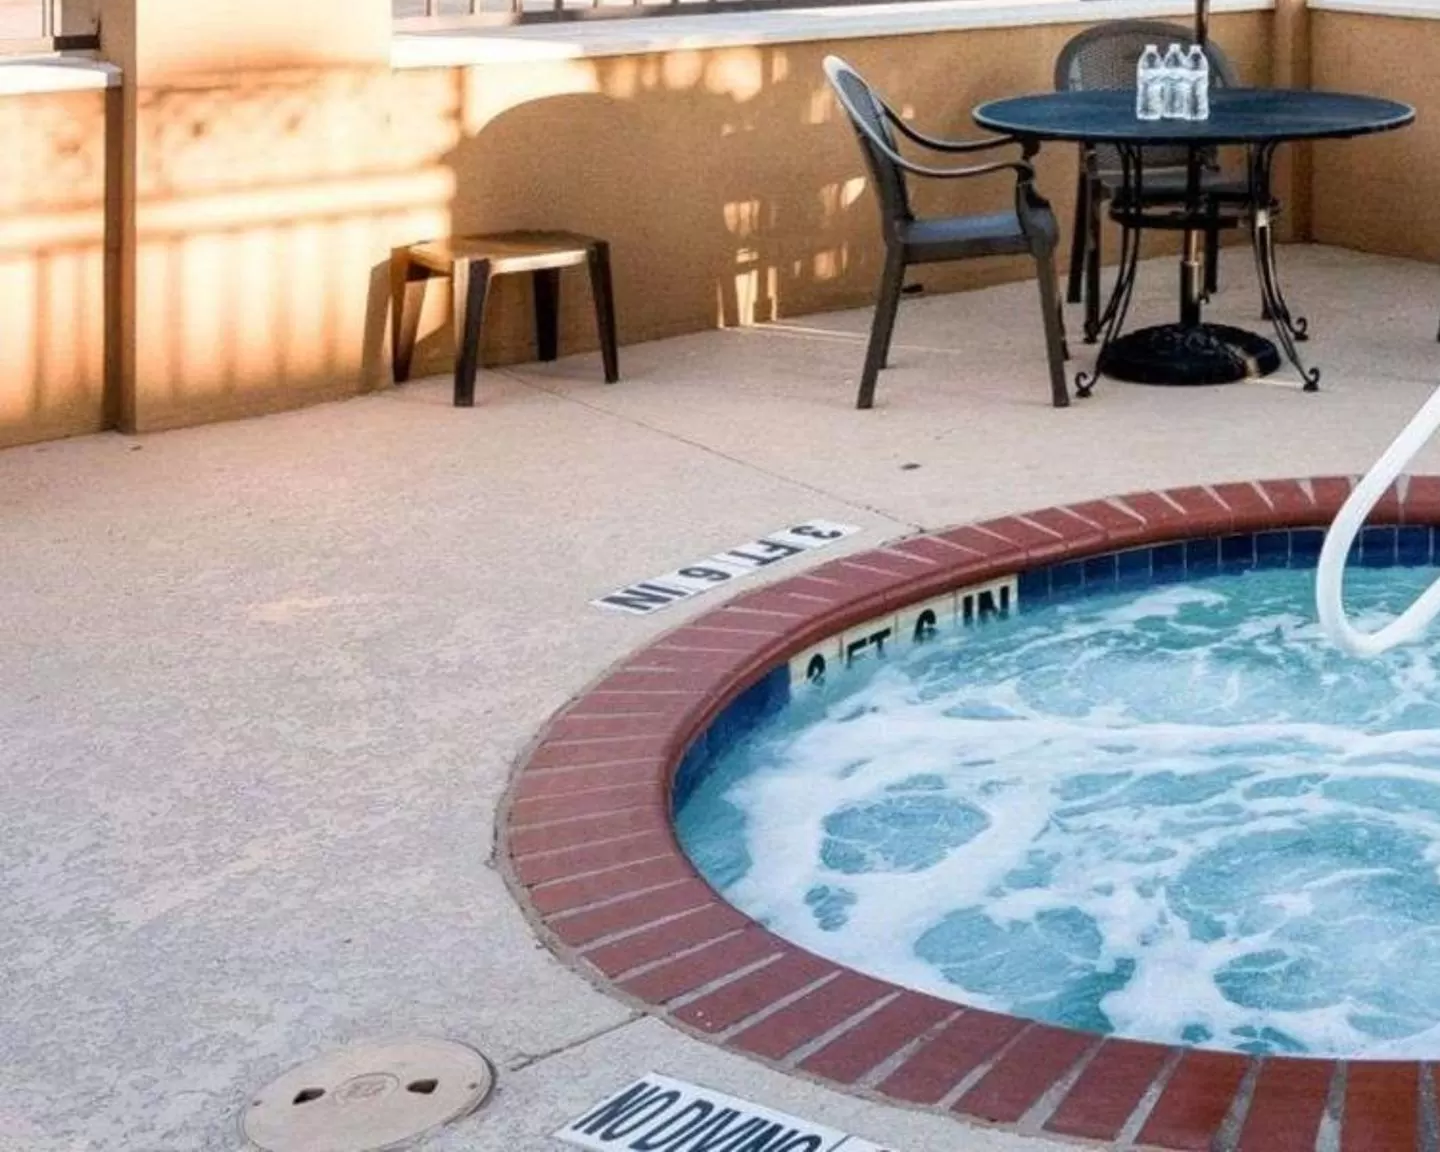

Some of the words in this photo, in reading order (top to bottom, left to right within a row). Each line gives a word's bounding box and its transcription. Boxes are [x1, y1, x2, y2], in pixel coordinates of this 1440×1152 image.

[790, 524, 843, 540] 3
[728, 538, 808, 566] FT
[678, 566, 733, 582] 6
[600, 582, 690, 612] IN
[570, 1081, 682, 1142] NO
